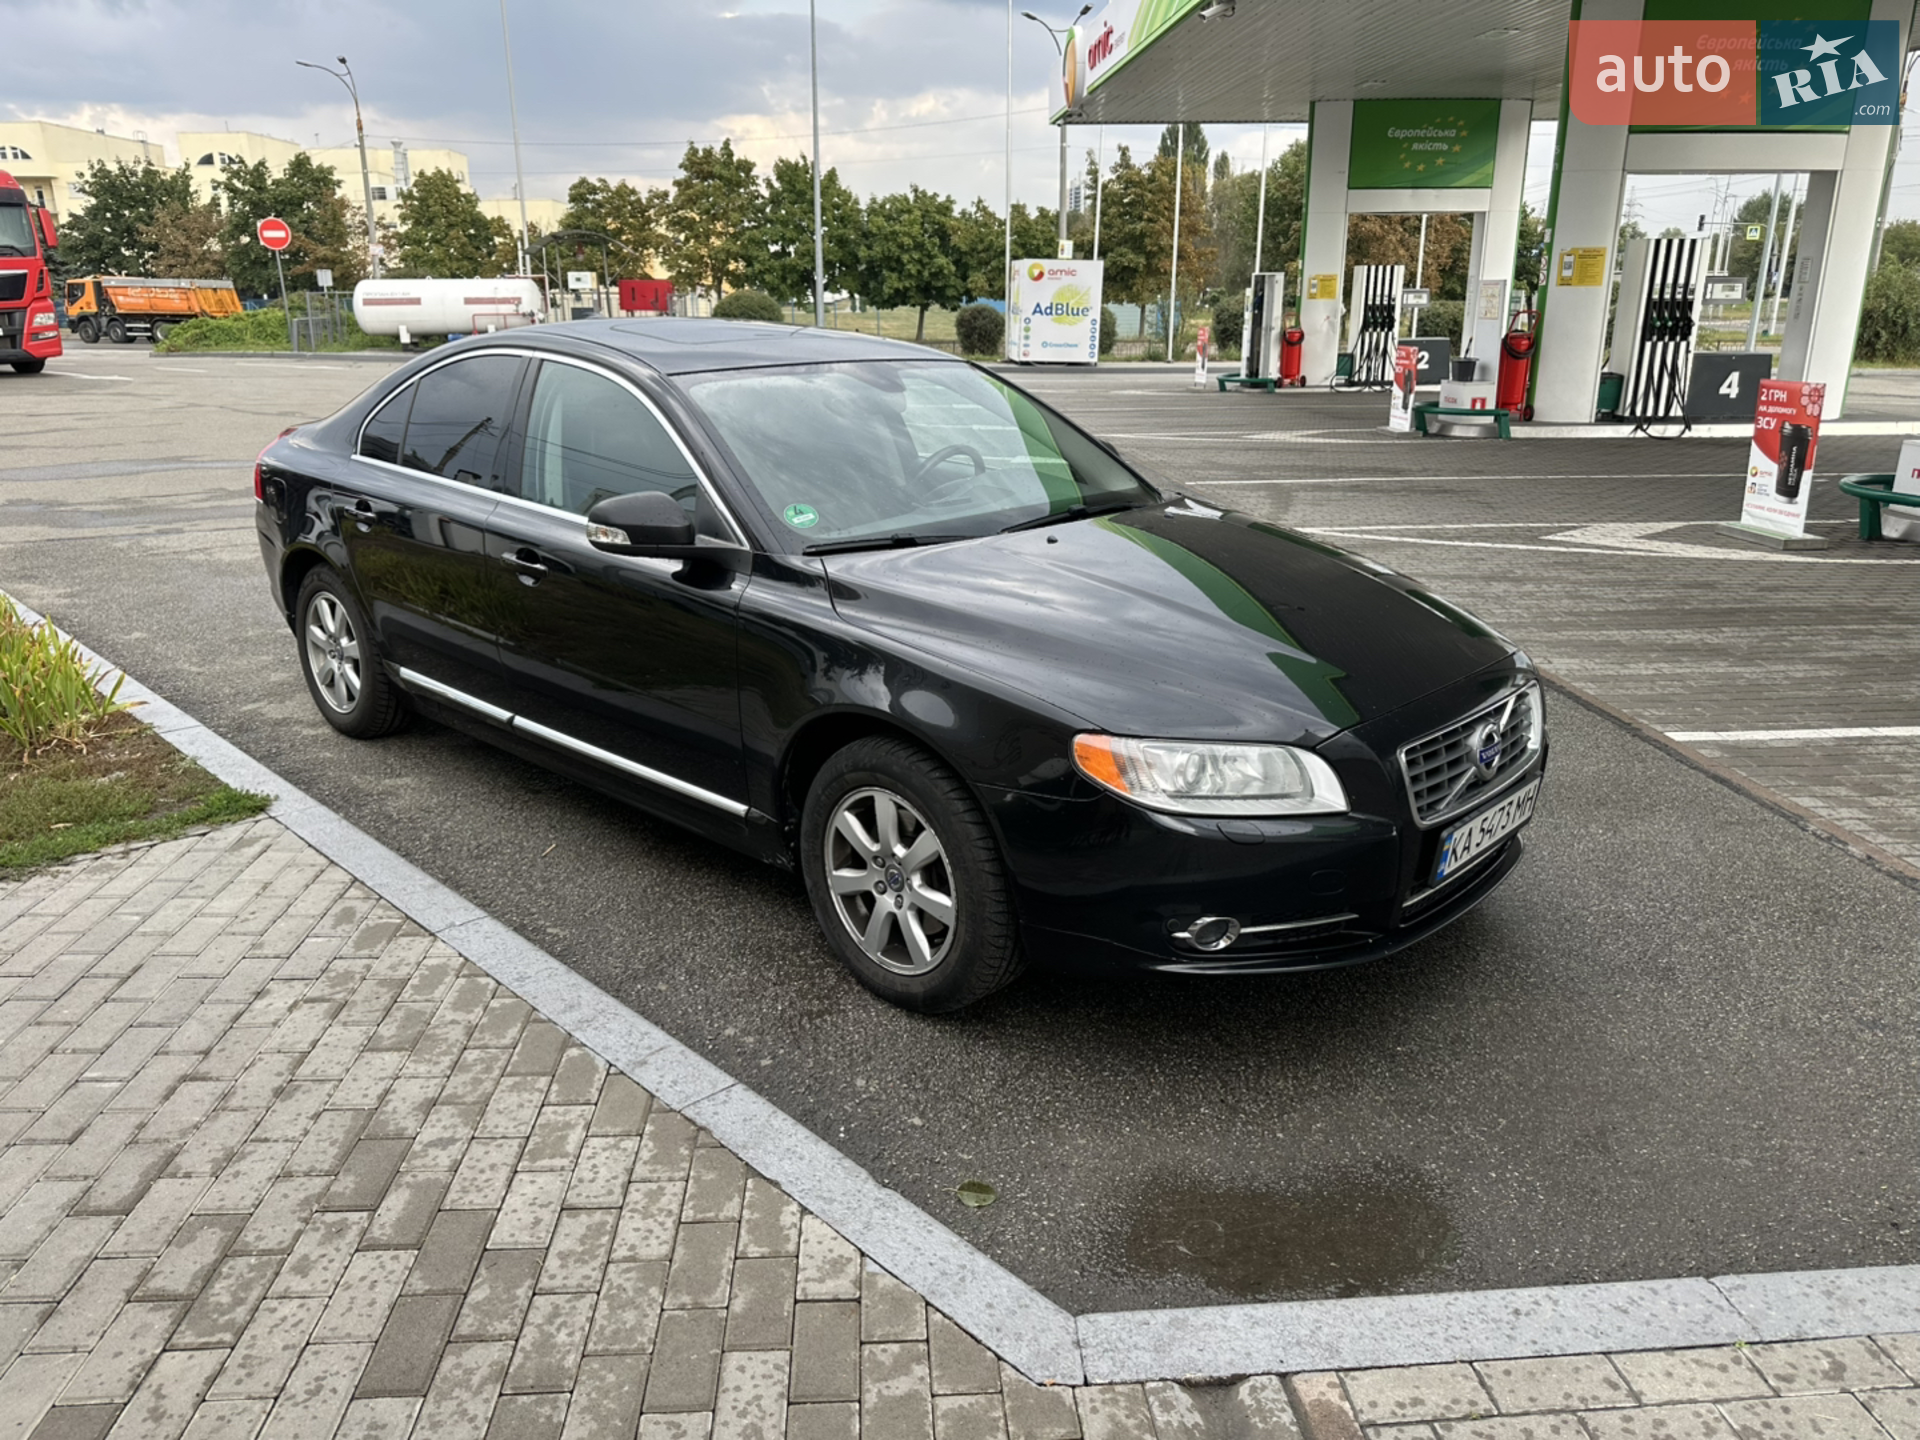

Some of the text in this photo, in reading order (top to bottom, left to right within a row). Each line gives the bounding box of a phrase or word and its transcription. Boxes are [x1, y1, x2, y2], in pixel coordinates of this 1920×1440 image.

[1088, 20, 1114, 70] amic
[1387, 127, 1458, 140] Європейська
[1411, 140, 1449, 151] якість
[1047, 267, 1078, 277] amic
[1417, 350, 1430, 369] 2
[1718, 371, 1741, 399] 4
[1760, 388, 1788, 403] 2 ГРН
[1756, 416, 1777, 430] ЗСУ
[1447, 783, 1538, 869] KA 5473 MH
